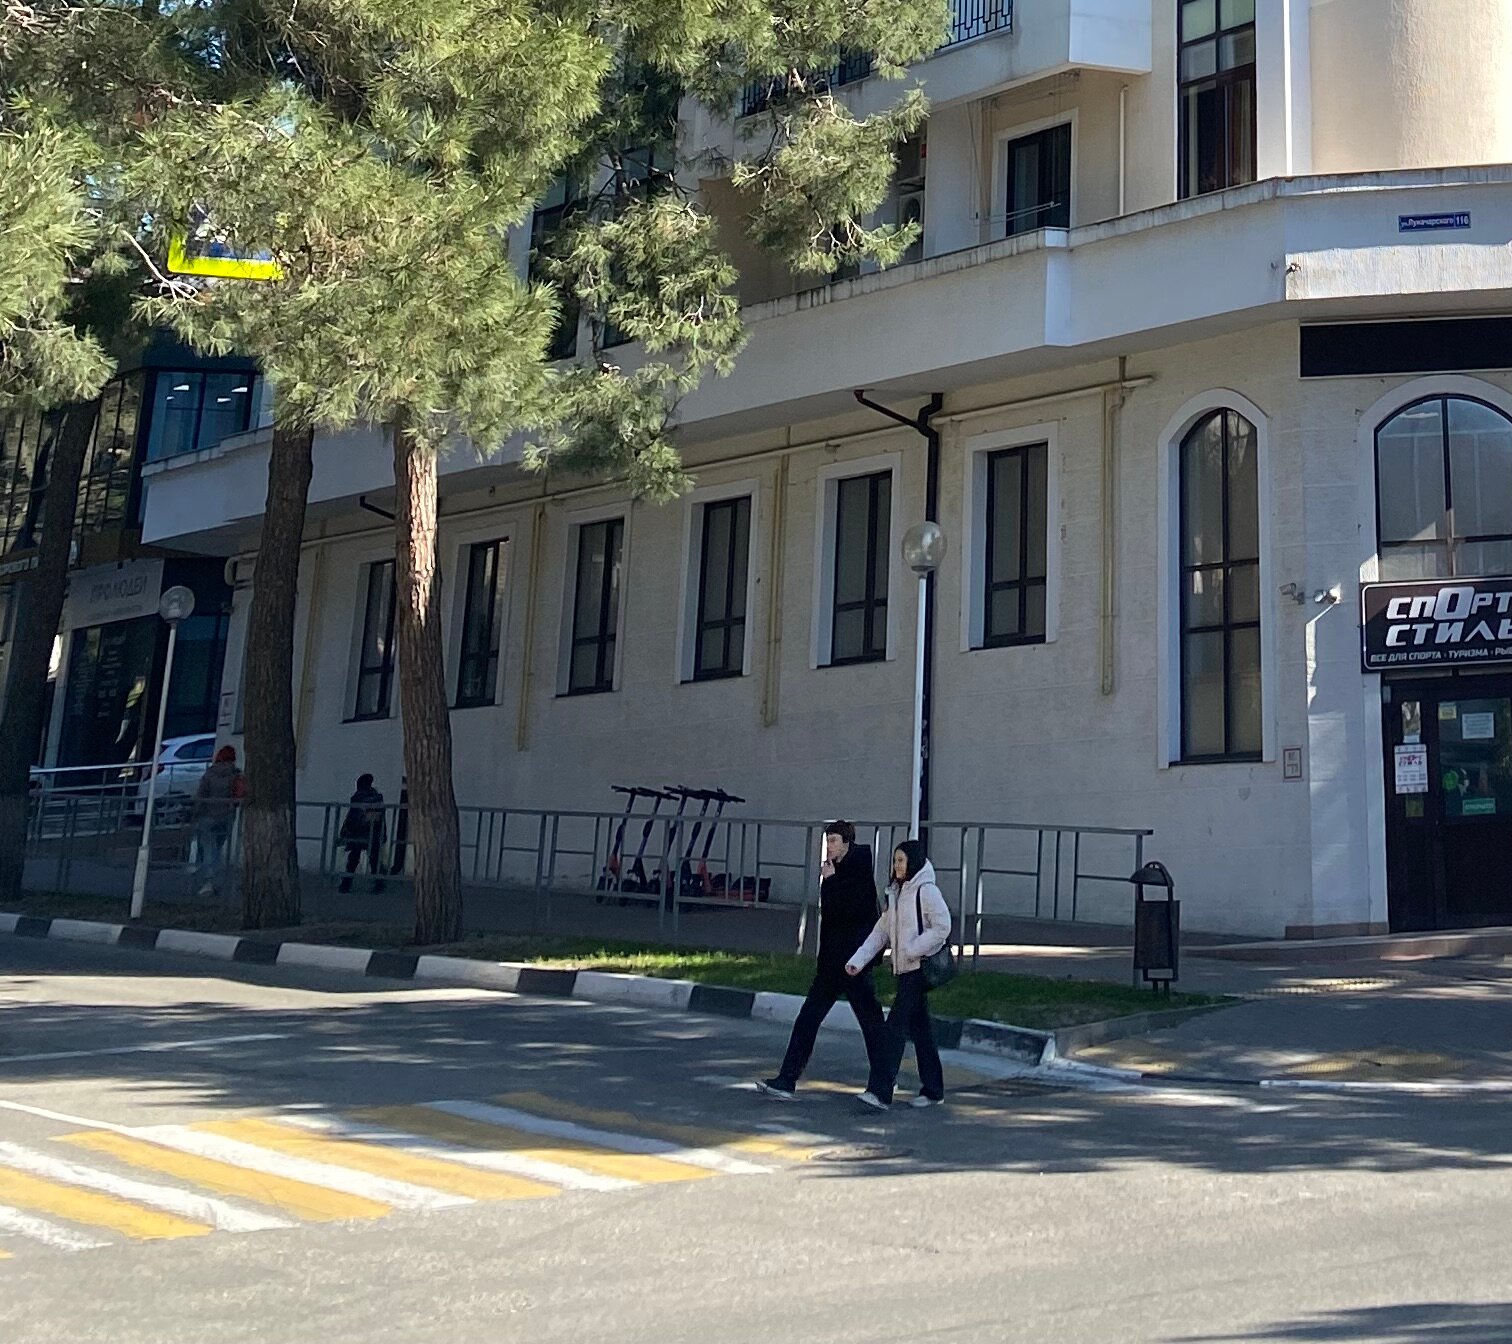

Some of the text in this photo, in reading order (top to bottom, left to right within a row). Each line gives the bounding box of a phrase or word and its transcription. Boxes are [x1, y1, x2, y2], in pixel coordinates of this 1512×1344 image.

[1370, 653, 1388, 663] ВСЕ
[1388, 652, 1407, 663] ДЛЯ
[1408, 650, 1442, 661] СПОРТА
[1448, 648, 1489, 659] ТУРИЗМА
